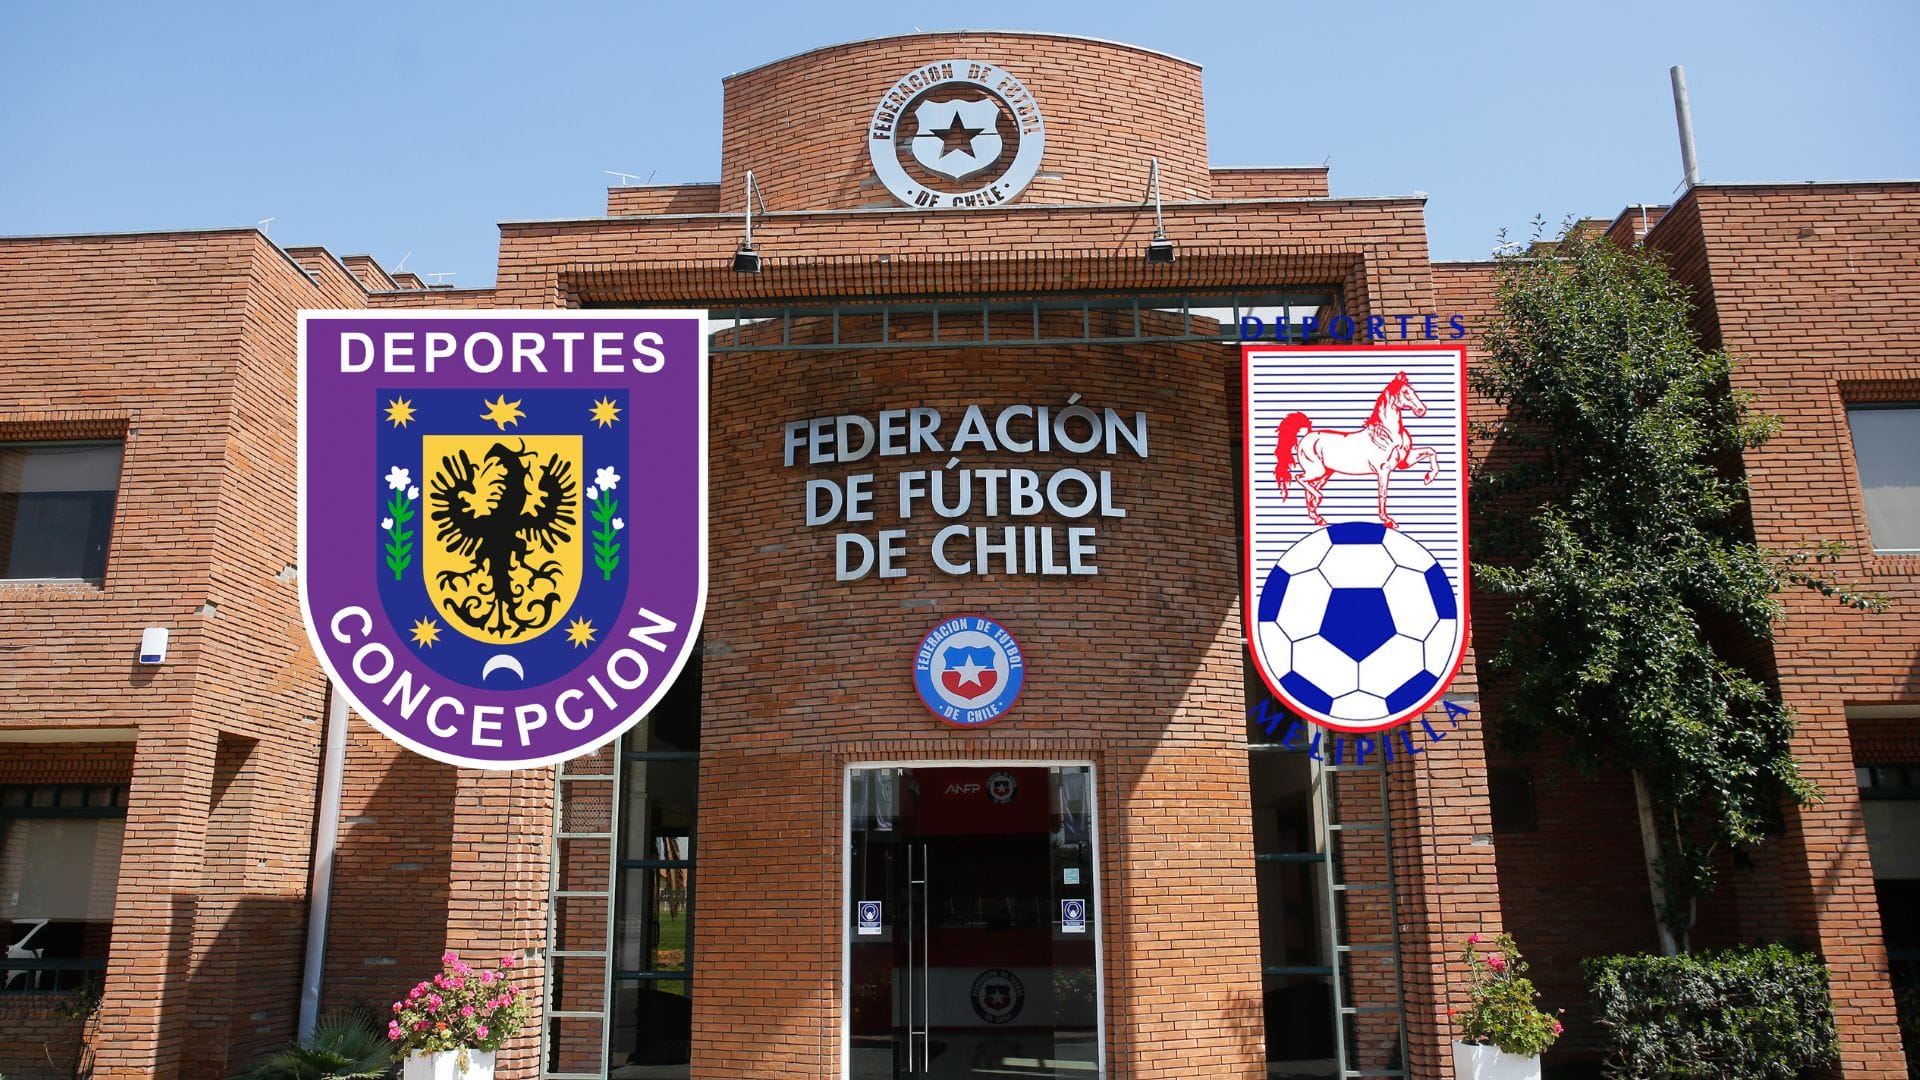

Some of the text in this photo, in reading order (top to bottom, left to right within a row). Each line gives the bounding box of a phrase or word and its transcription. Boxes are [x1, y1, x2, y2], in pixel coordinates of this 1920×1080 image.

[872, 63, 1041, 140] FEDERACION DE FUTBOL
[915, 185, 1005, 207] DE CHILE
[784, 392, 1148, 467] FEDERACIÓN
[806, 456, 1126, 526] DE FÚTBOL
[836, 524, 1098, 581] DE CHILE
[917, 618, 1022, 671] FEDERACION DE FUTBOL
[944, 704, 1000, 722] DE CHILE
